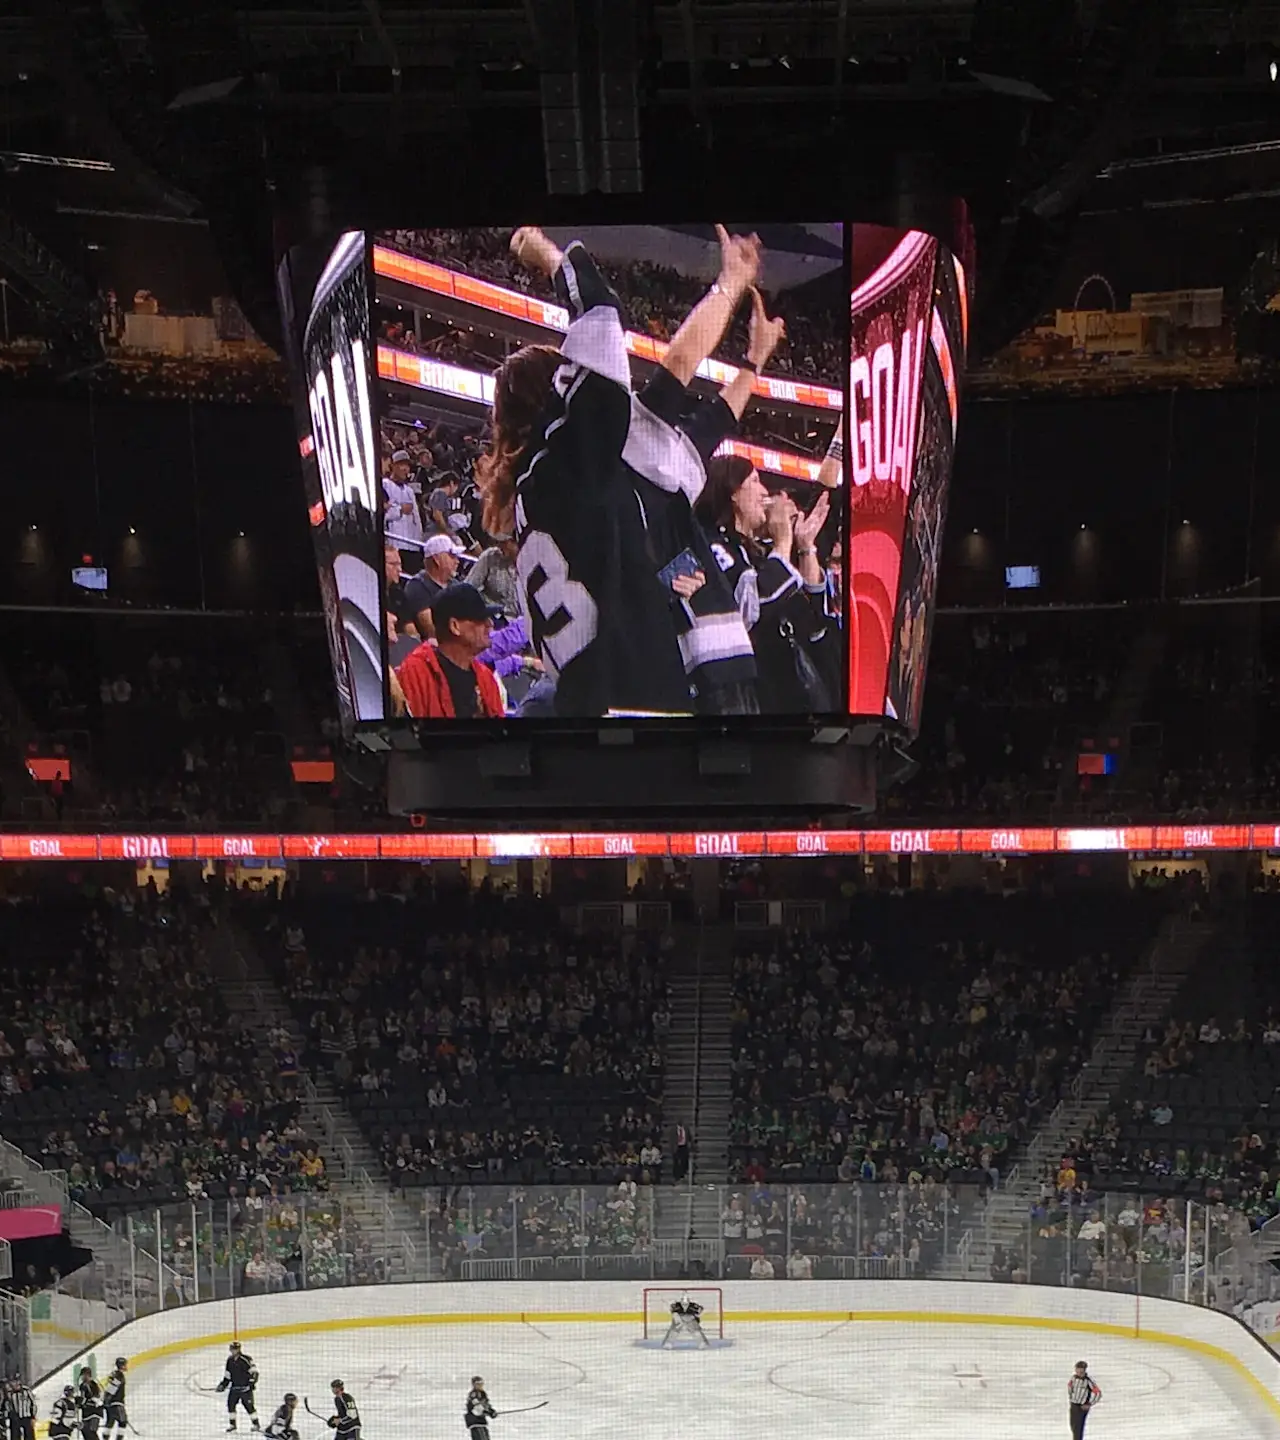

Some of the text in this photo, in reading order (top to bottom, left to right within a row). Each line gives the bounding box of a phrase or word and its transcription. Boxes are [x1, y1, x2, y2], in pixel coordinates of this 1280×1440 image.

[603, 838, 635, 853] GOAL
[695, 834, 743, 854] GOAL
[796, 836, 828, 851] GOAL
[890, 832, 934, 852] GOAL
[990, 833, 1023, 849] GOAL
[1183, 829, 1216, 846] GOAL
[29, 839, 64, 856] GOAL
[223, 839, 256, 855] GOAL
